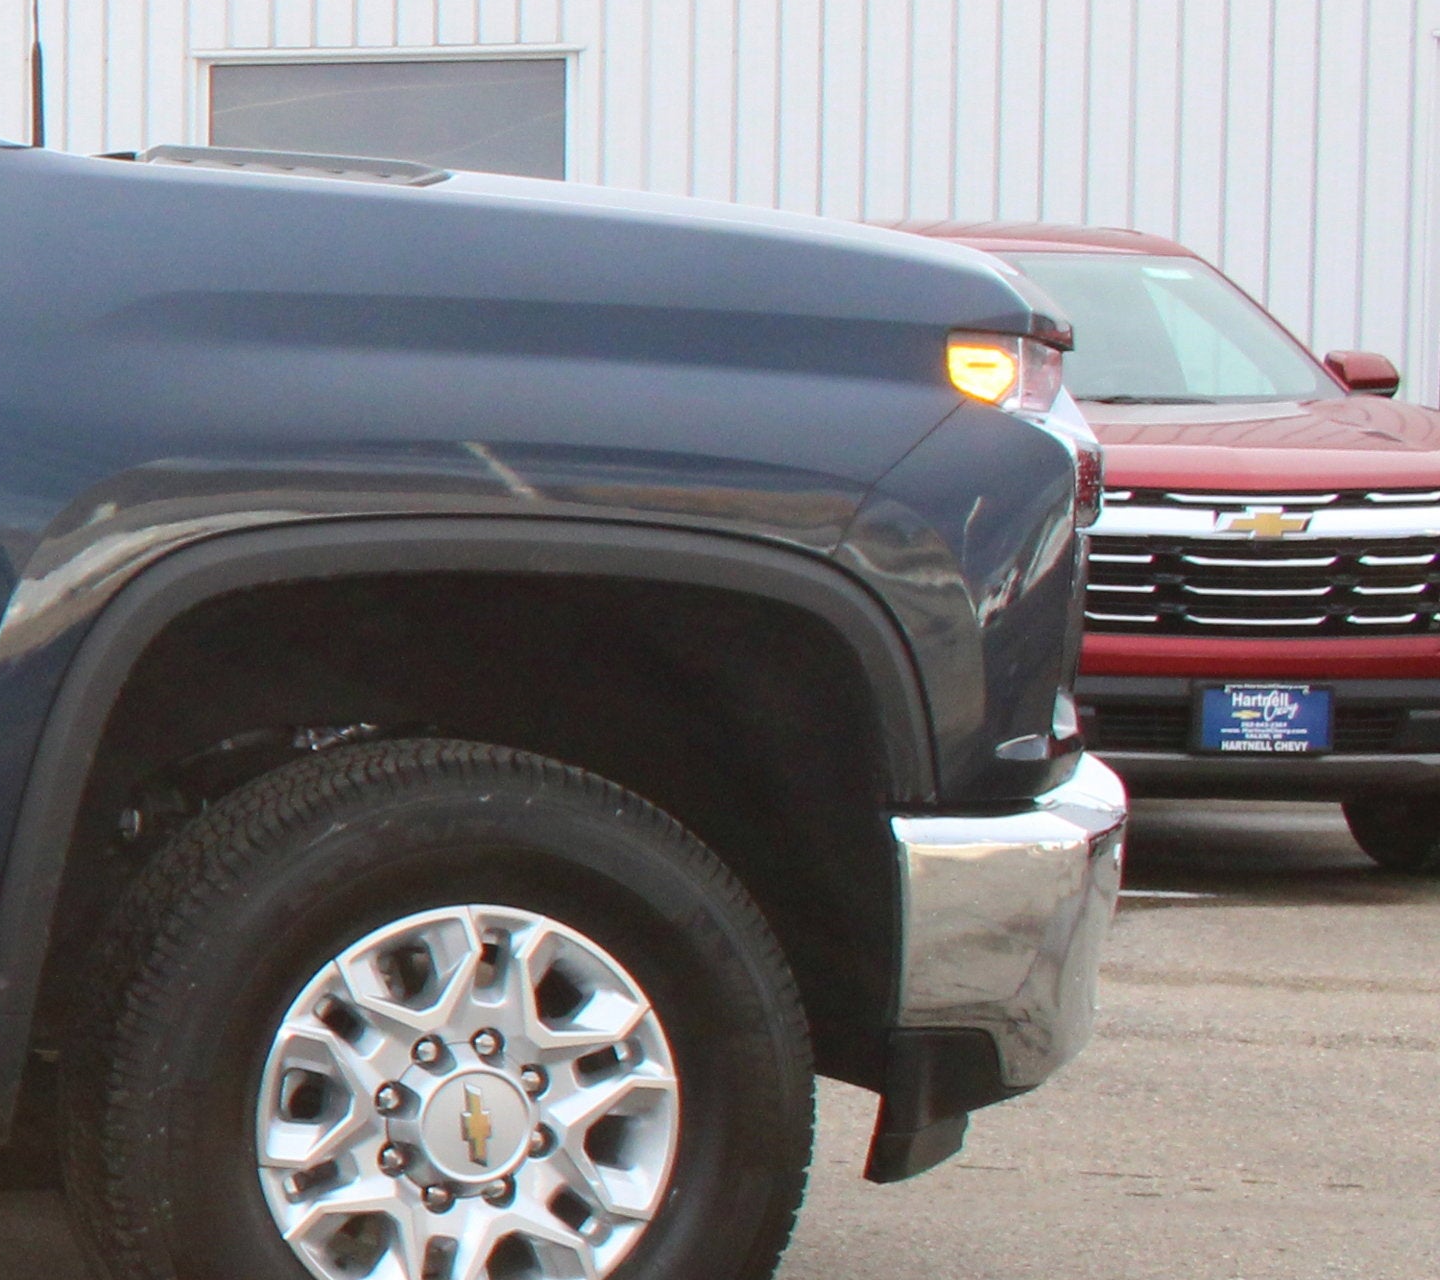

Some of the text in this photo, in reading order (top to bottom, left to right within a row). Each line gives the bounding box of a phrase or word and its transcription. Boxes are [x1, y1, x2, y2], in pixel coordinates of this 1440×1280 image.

[1232, 692, 1289, 707] Hartnell
[1221, 741, 1308, 751] HARTNELL CHEVY
